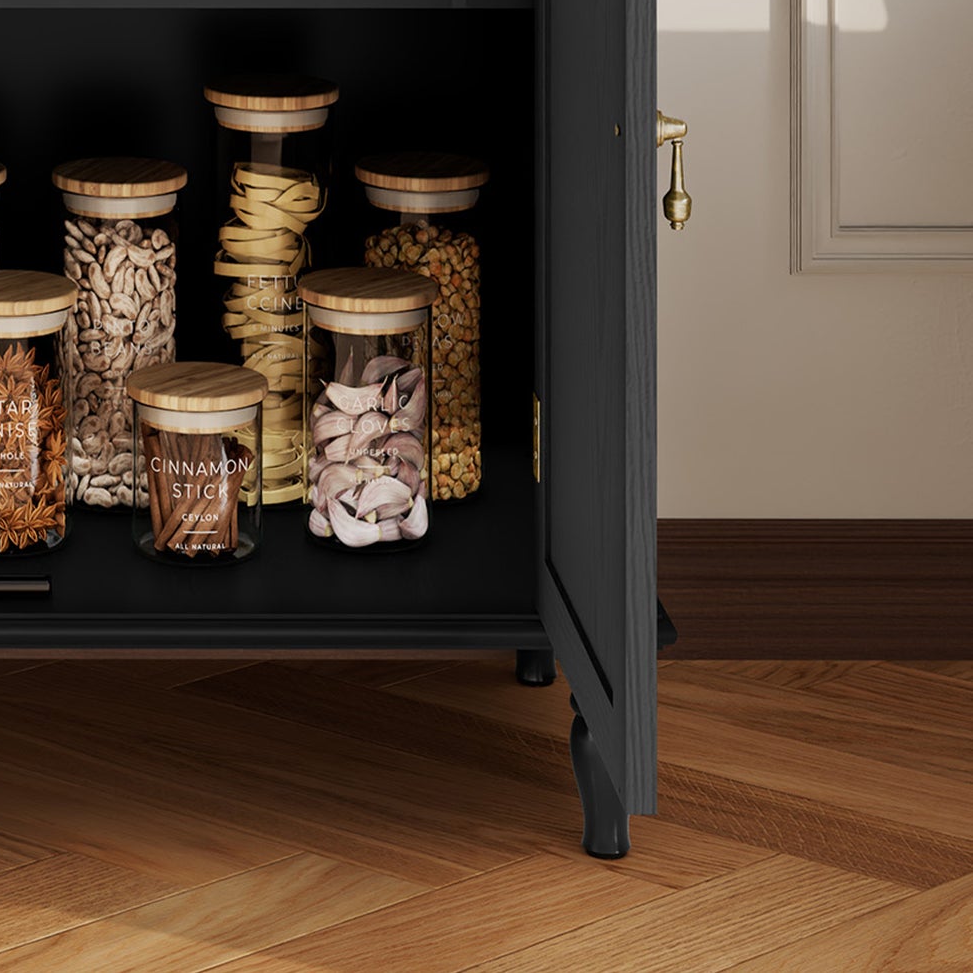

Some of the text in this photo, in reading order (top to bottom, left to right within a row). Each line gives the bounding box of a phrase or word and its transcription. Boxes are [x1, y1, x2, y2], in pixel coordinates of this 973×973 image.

[246, 295, 304, 311] CCINE
[337, 417, 410, 434] CLOVES
[150, 457, 249, 477] CINNAMON
[172, 482, 229, 500] STICK
[181, 513, 220, 523] CEYLON
[175, 543, 227, 552] ALL NATURAL
